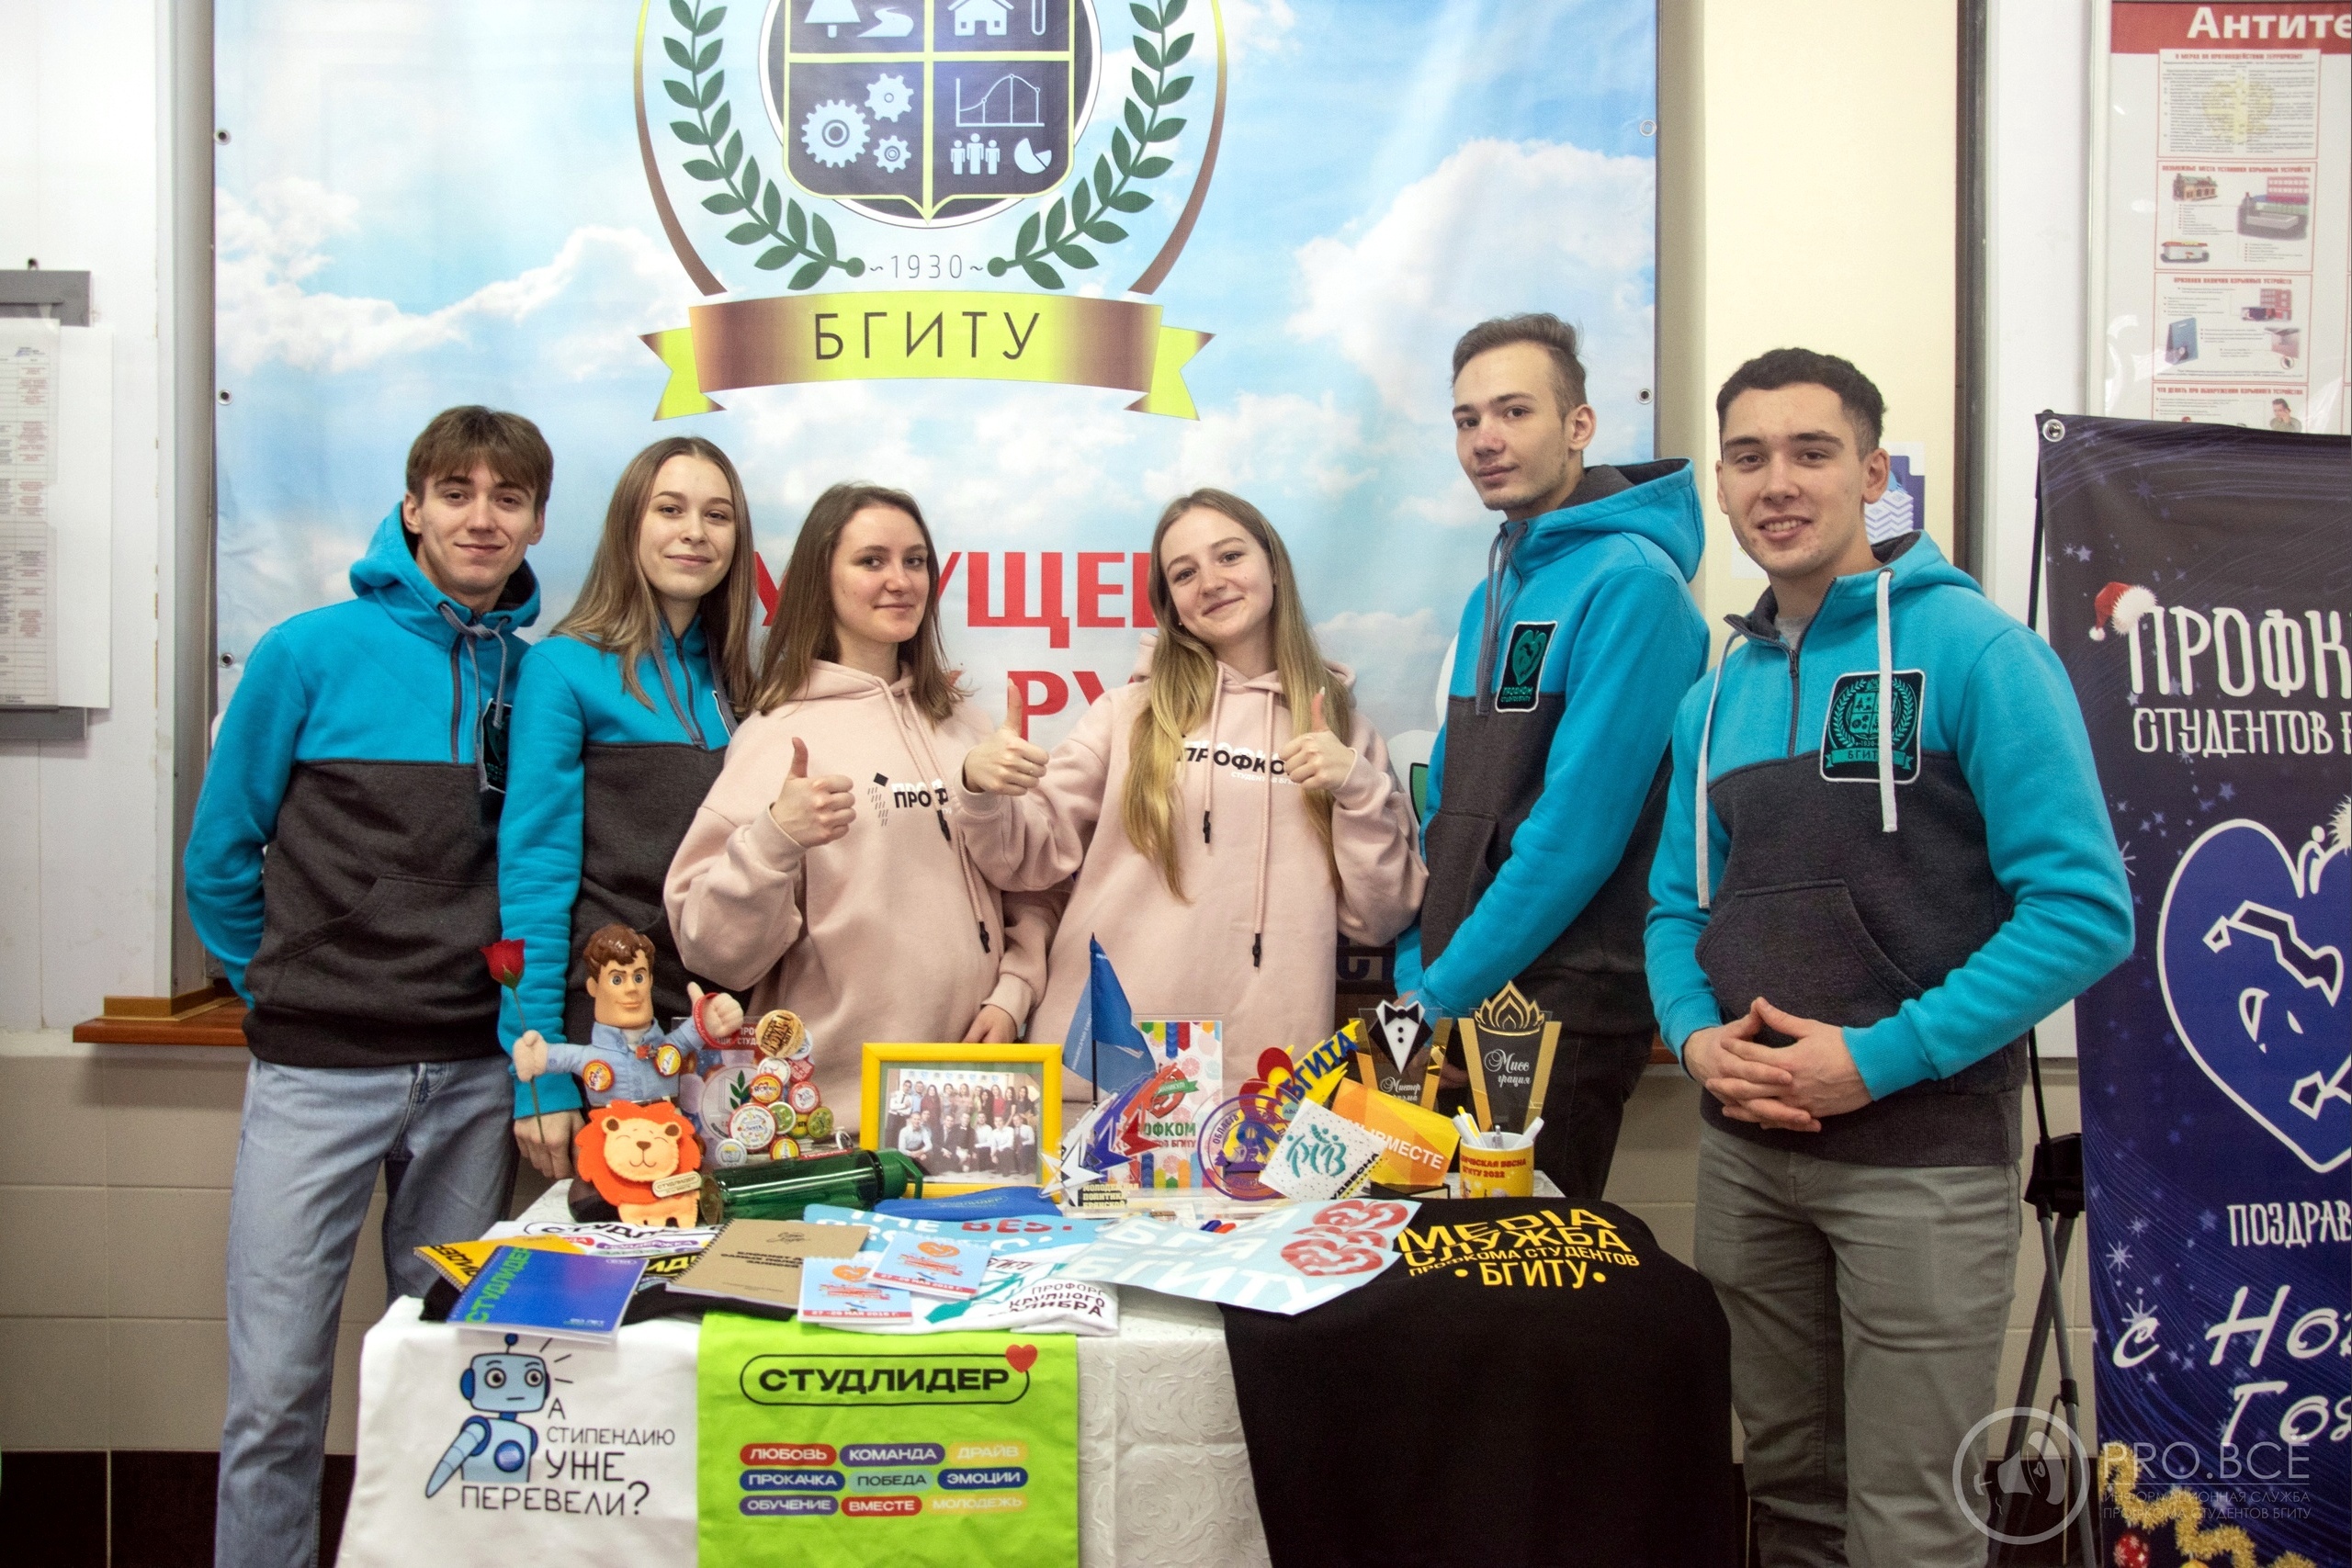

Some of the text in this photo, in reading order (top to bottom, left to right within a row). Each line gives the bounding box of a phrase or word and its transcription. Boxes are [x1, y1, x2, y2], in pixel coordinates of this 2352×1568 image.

[2187, 6, 2352, 39] Антите
[814, 310, 1040, 361] БГИТУ
[2132, 707, 2334, 759] СТУДЕНТОВ
[1848, 750, 1880, 760] БГИТ
[1484, 1048, 1531, 1074] Мисс
[1403, 1227, 1633, 1268] СЛУЖБА
[1408, 1245, 1641, 1277] ПРОФКОМА СТУДЕНТОВ
[1032, 1282, 1106, 1295] ПРОФОРГ
[1479, 1259, 1588, 1290] БГИТУ
[758, 1367, 1010, 1395] СТУДЛИДЕР
[547, 1398, 567, 1421] А
[547, 1426, 676, 1446] СТИПЕНДИЮ
[545, 1450, 626, 1483] УЖЕ
[749, 1444, 1020, 1462] ЛЮБОВЬ КОМАНДА ДРАЙВ
[748, 1470, 1021, 1488] ПРОКАЧКА ПОБЕДА ЭМОЦИИ
[459, 1480, 650, 1517] ПЕРЕВЕЛИ?
[747, 1495, 1023, 1513] ОБУЧЕНИЕ ВМЕСТЕ МОЛОДЕЖЬ
